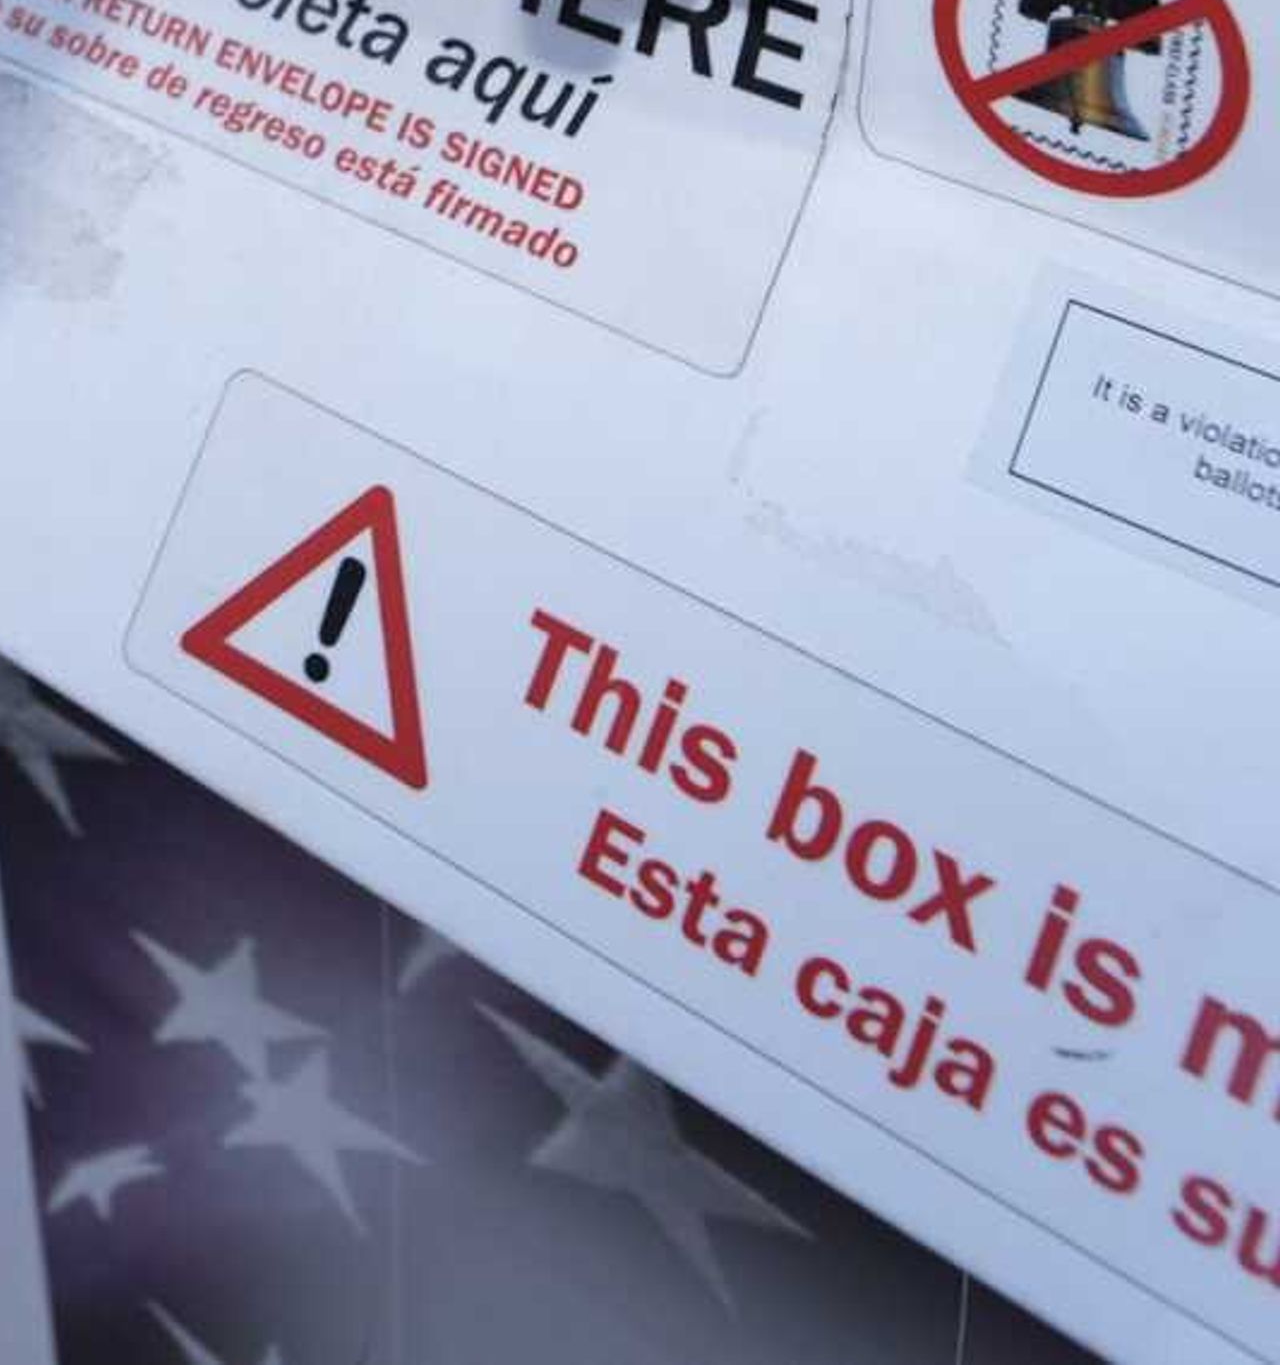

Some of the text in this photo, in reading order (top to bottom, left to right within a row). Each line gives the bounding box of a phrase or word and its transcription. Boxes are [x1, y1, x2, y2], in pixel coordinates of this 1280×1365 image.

[6, 6, 48, 38] su
[50, 24, 140, 79] sobre
[146, 63, 189, 100] de
[194, 84, 326, 161] regreso
[335, 147, 421, 198] está
[424, 179, 580, 269] firmado
[215, 40, 393, 134] ENVELOPE
[397, 112, 435, 151] IS
[441, 131, 583, 212] SIGNED
[425, 36, 613, 137] aquí
[1092, 374, 1280, 467] It is a violatio
[523, 608, 739, 805] This
[766, 749, 997, 952] box
[1024, 885, 1144, 1028] is
[576, 809, 770, 977] Esta
[794, 955, 997, 1112] caja
[1025, 1089, 1145, 1196] es
